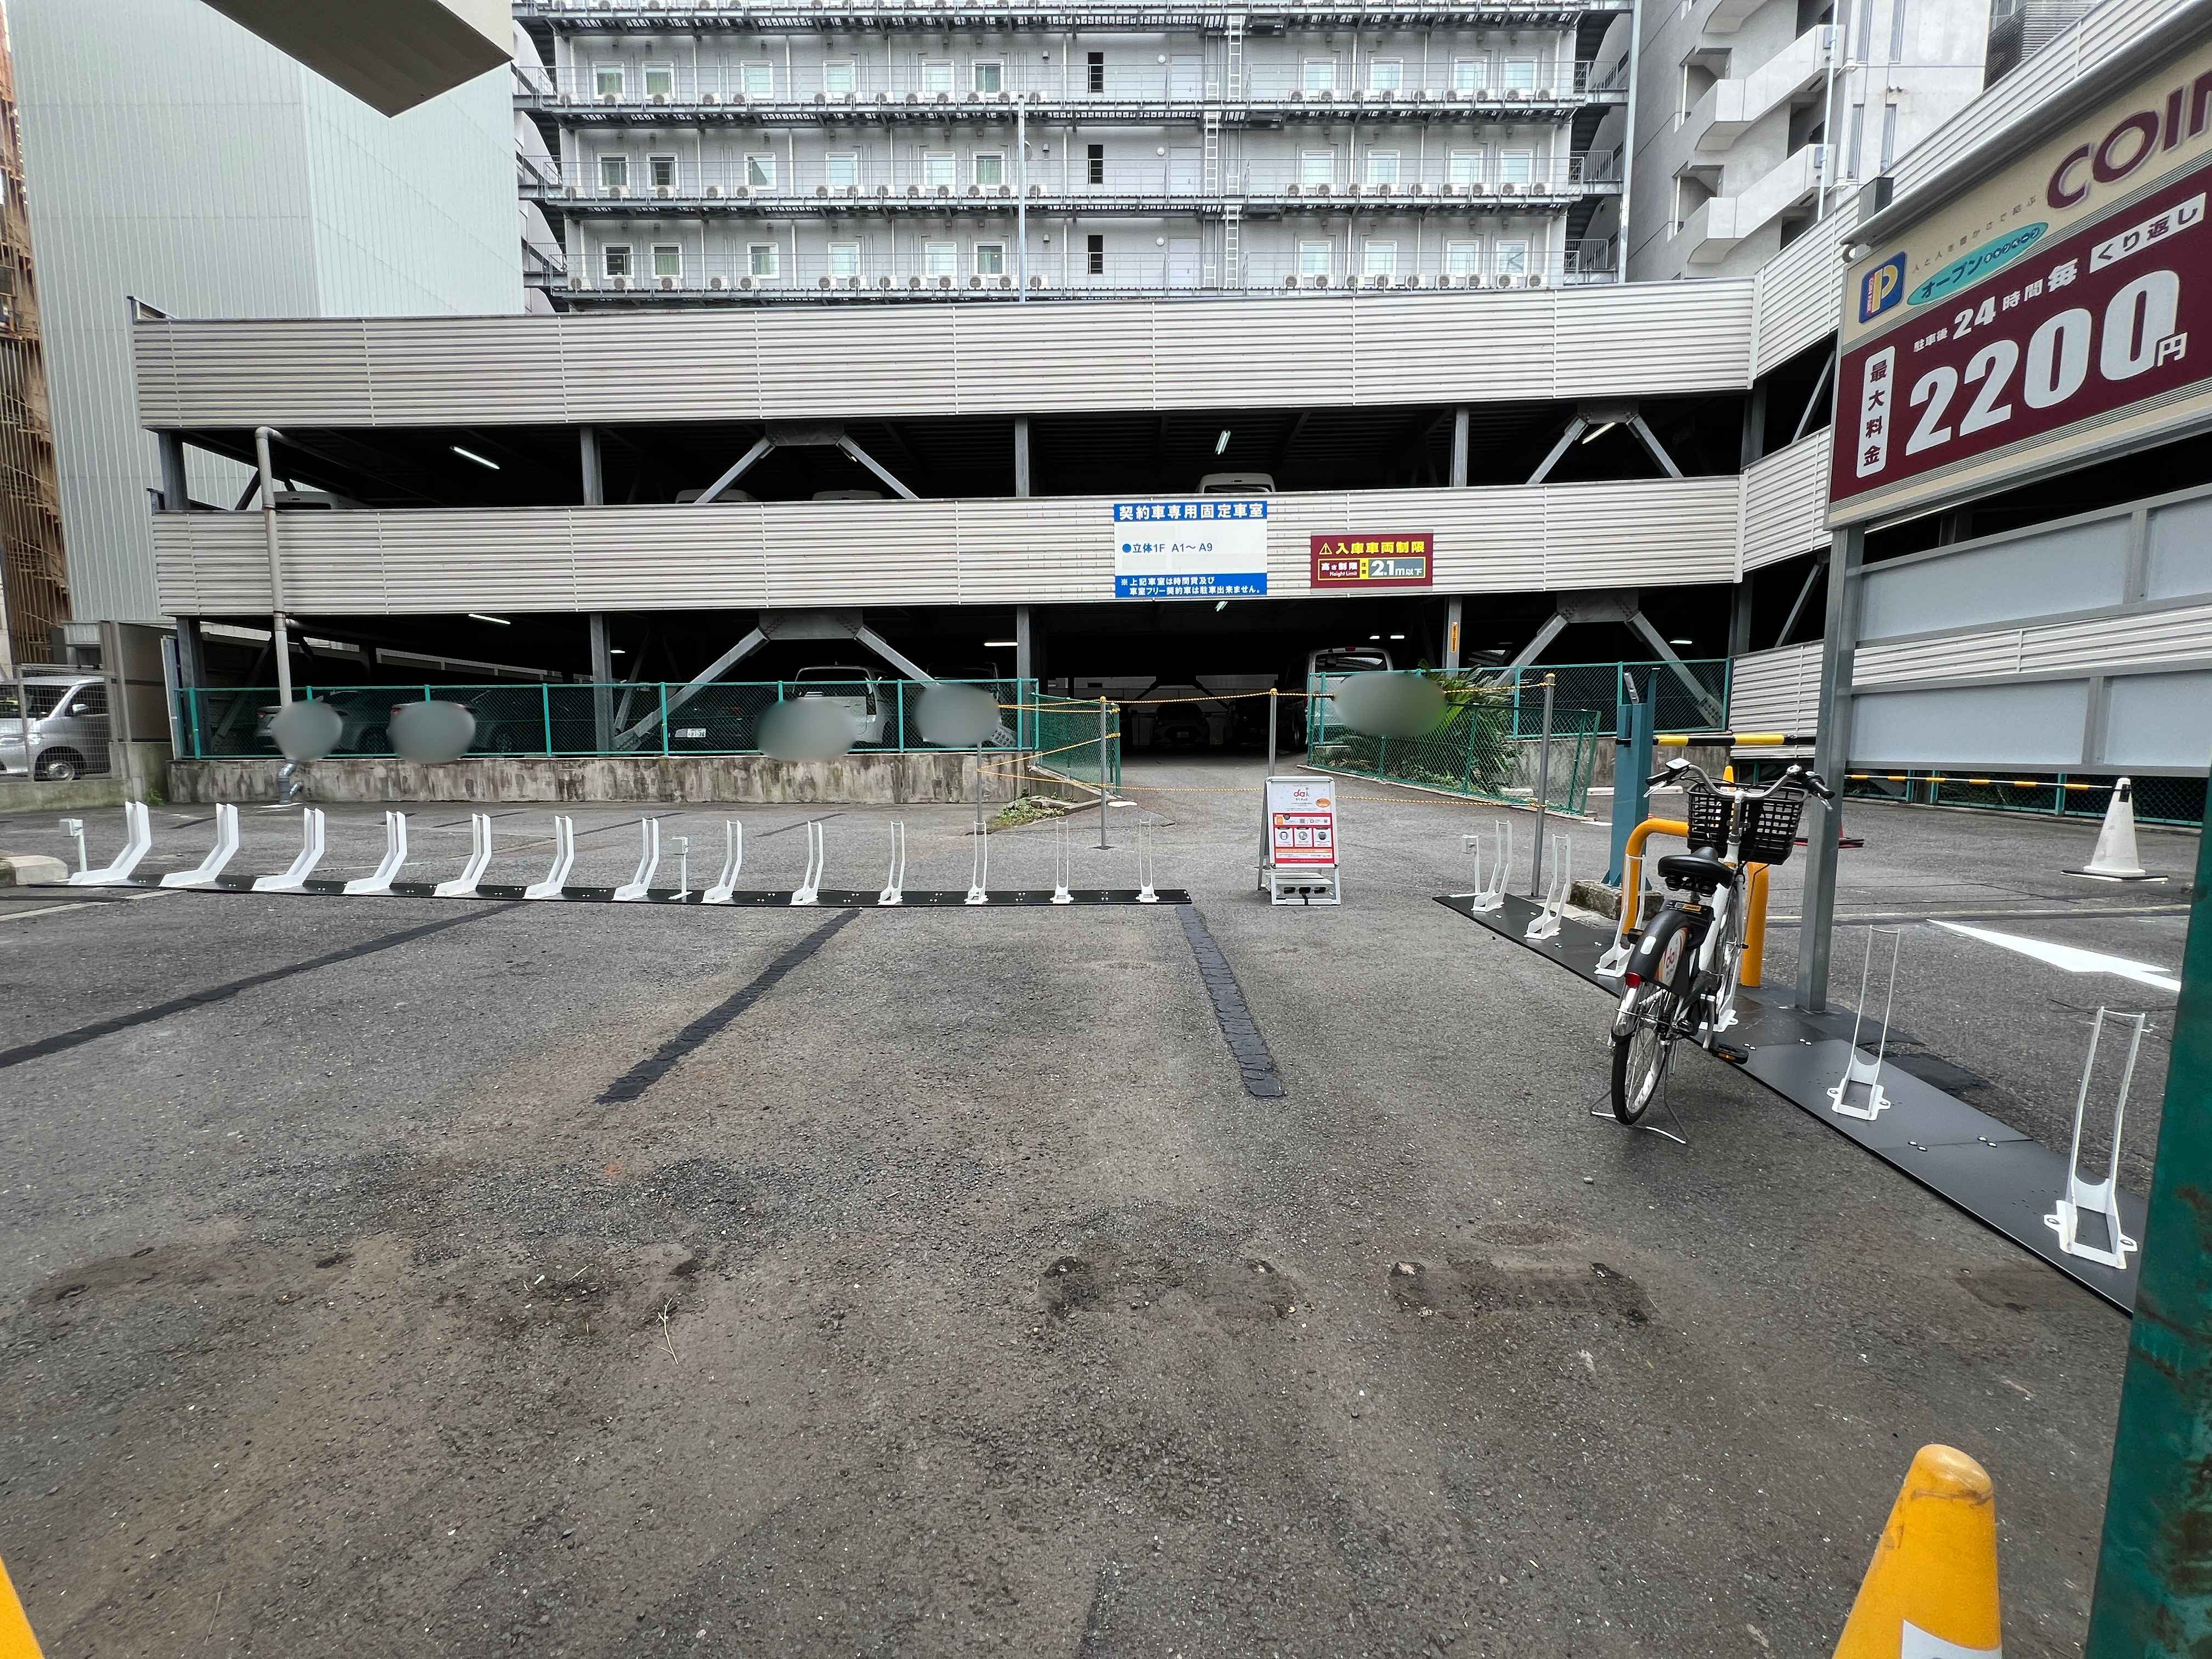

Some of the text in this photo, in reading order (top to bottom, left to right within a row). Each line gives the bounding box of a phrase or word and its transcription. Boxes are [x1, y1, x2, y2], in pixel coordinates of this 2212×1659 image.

[2097, 207, 2198, 261] くり返し
[1863, 358, 1888, 467] 最大料金
[1119, 503, 1263, 521] 契約車専用固定車室
[1335, 541, 1425, 555] 入庫車両制限
[1321, 562, 1358, 571] 高さ制限
